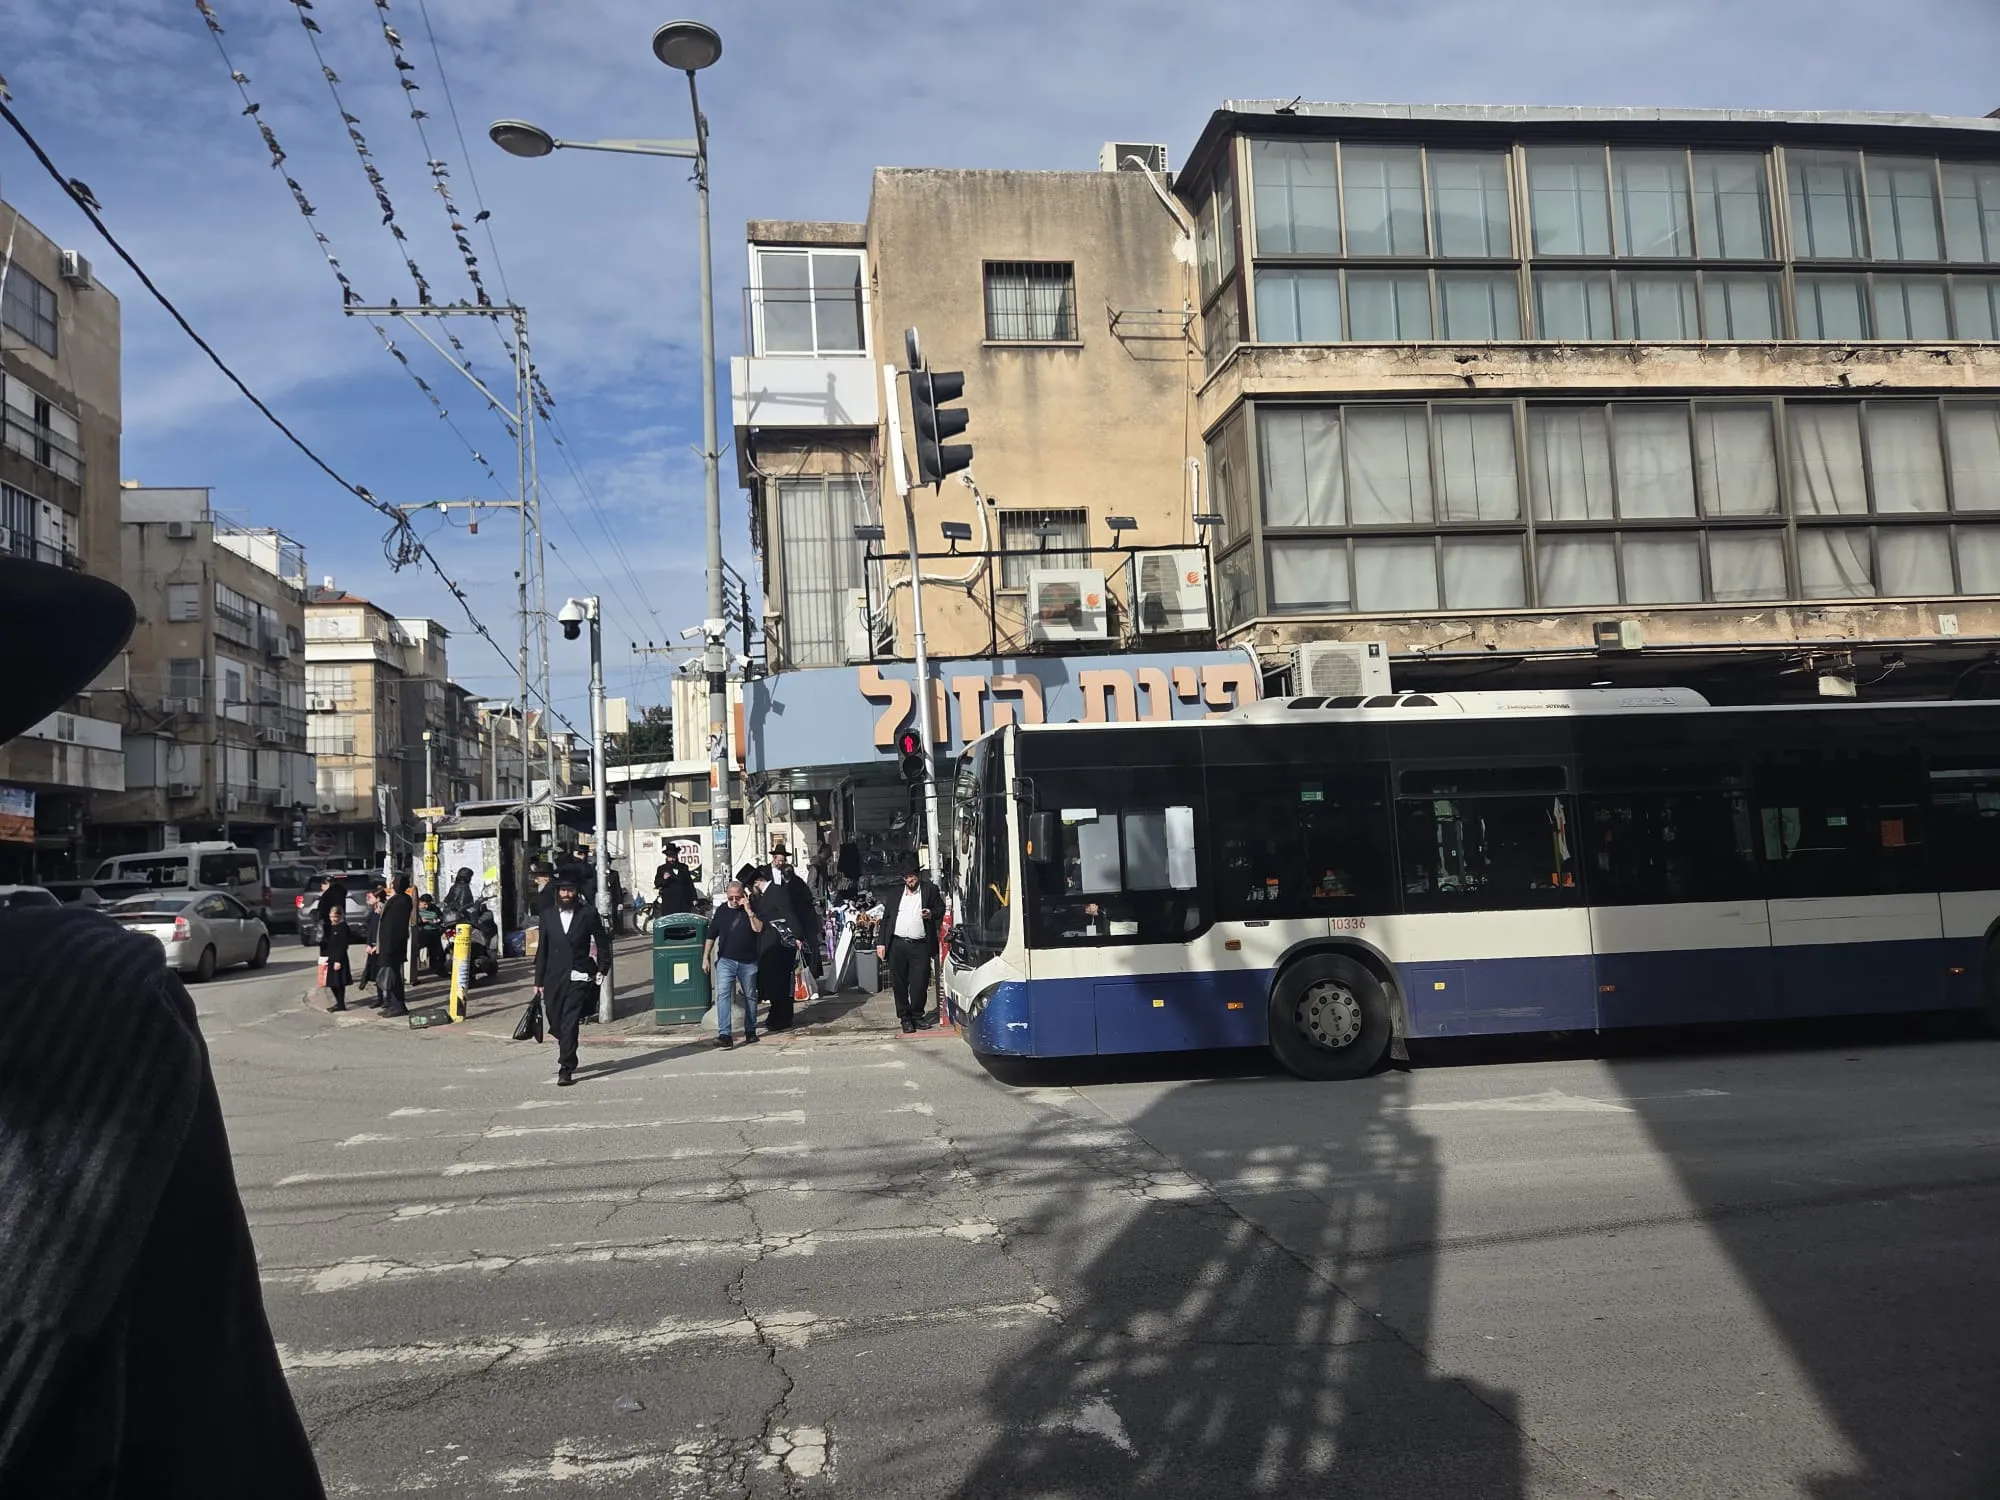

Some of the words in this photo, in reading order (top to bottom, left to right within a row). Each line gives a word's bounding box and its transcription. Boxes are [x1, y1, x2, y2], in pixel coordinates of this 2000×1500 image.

[1078, 662, 1258, 723] פינת
[858, 665, 1044, 746] הזול
[680, 844, 699, 854] מרכ
[680, 855, 700, 864] הספ
[1331, 917, 1366, 930] 10336
